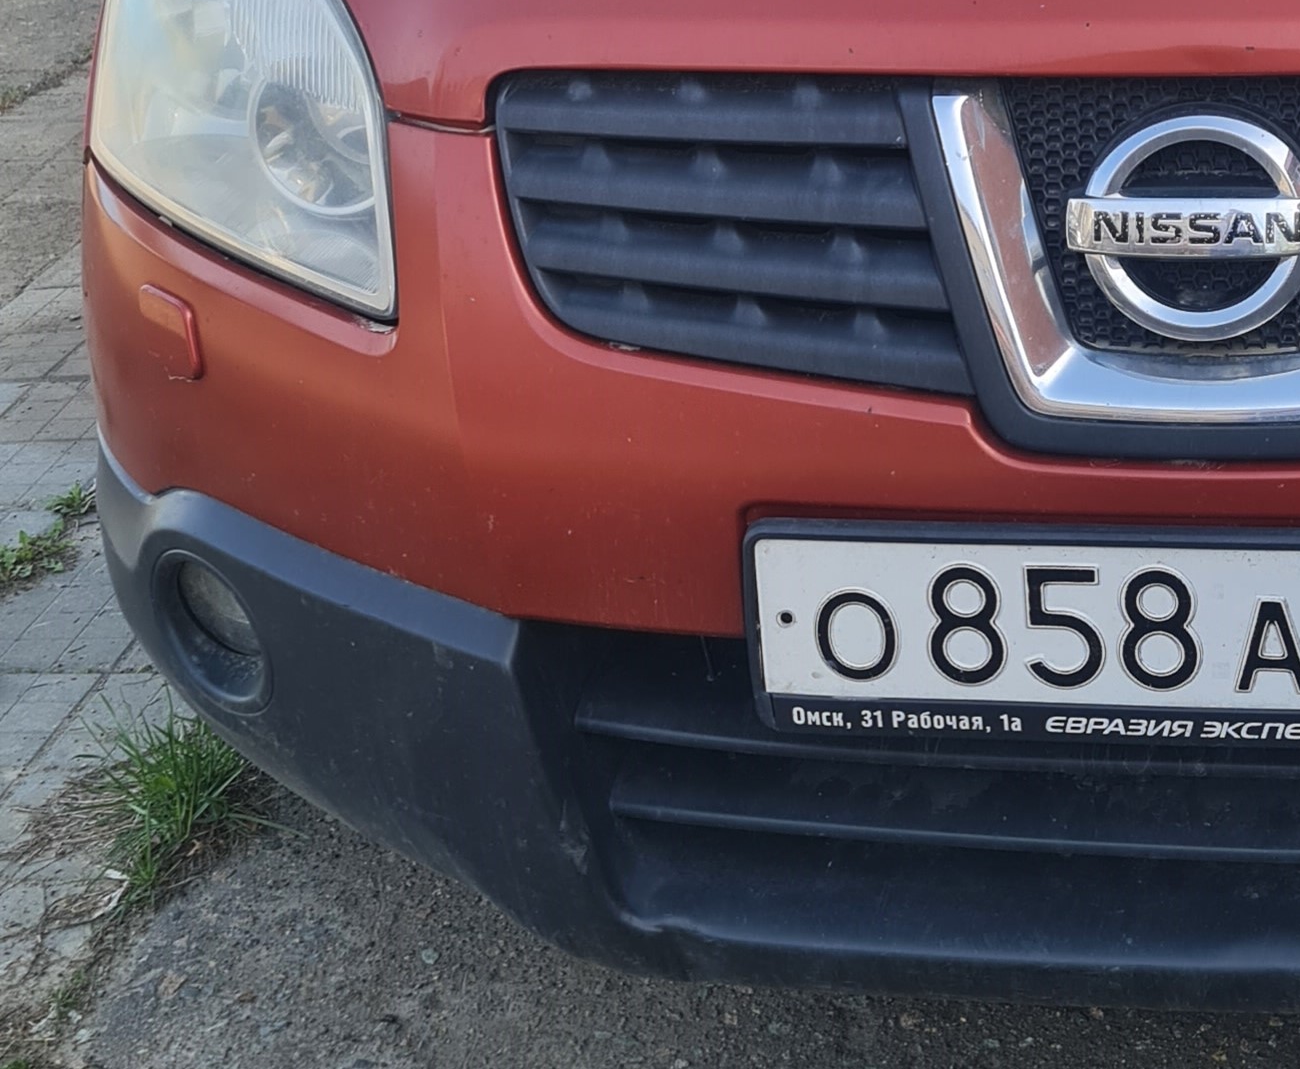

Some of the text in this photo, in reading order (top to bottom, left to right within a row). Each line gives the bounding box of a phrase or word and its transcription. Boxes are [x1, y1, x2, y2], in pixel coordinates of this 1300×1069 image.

[792, 707, 852, 729] Омск,
[860, 710, 884, 728] 31
[892, 711, 992, 733] Рабочая,
